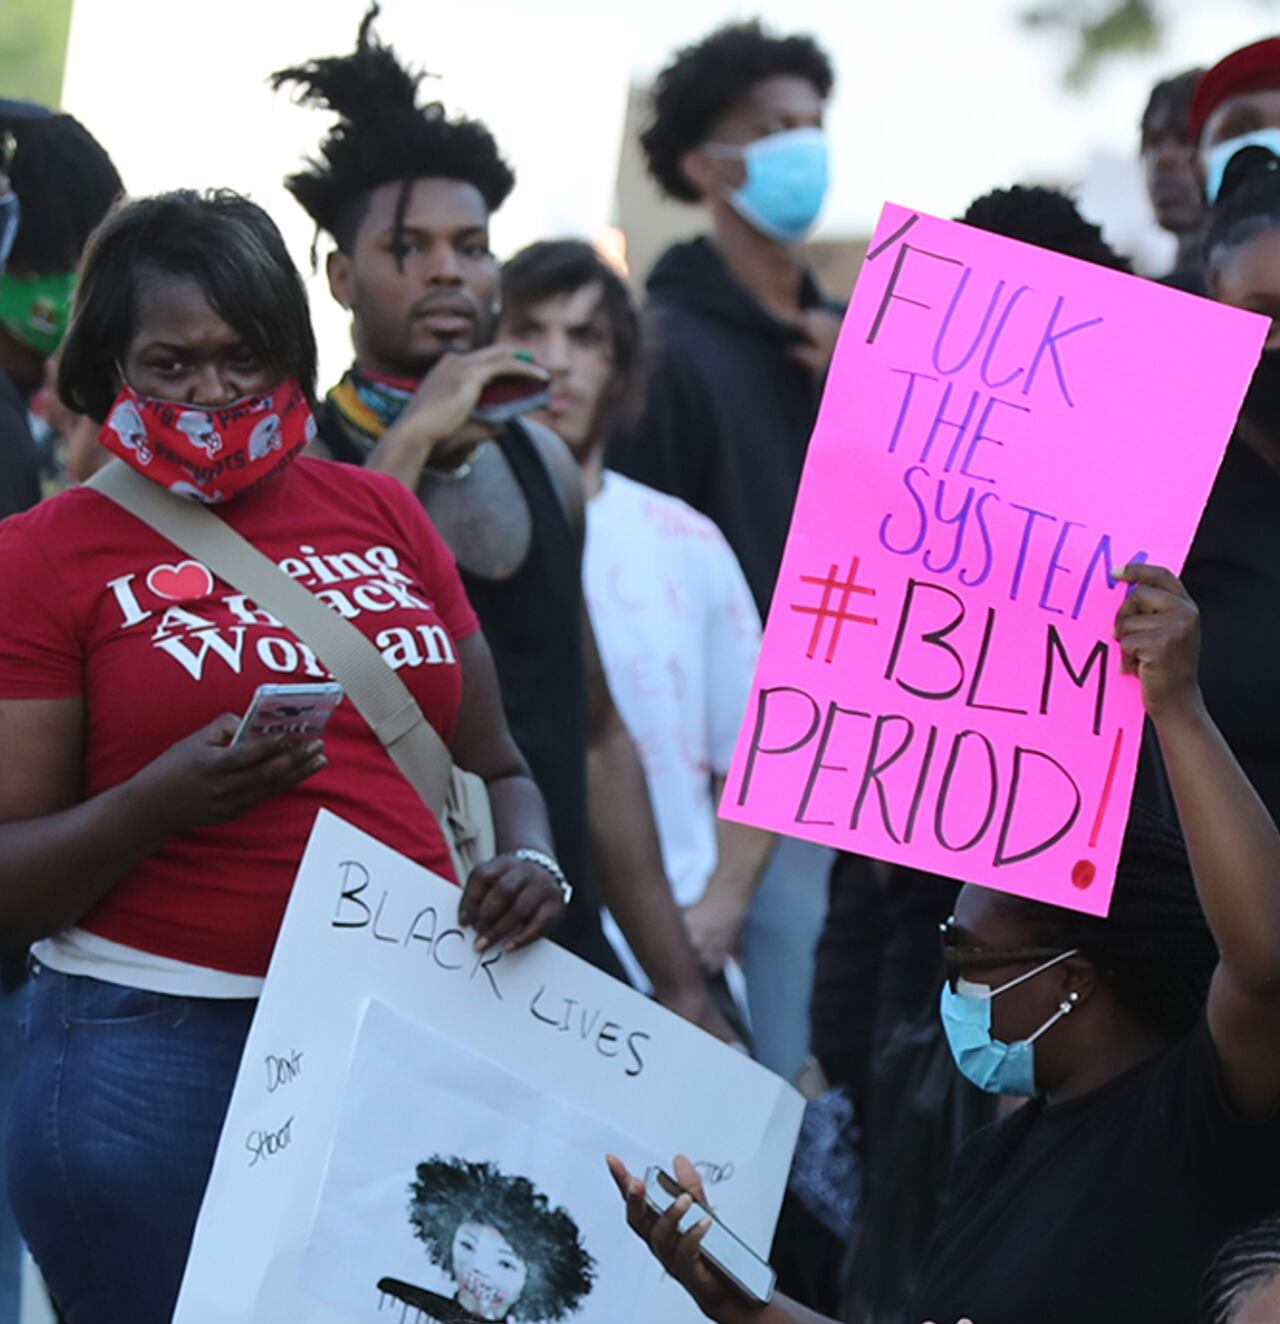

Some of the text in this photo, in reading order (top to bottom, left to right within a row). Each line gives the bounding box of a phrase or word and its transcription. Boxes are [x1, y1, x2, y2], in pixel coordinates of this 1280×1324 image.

[867, 243, 1103, 408] FUCK
[887, 367, 1032, 485] THE
[879, 466, 1150, 621] SYSTEM
[790, 555, 1109, 736] #BLM
[737, 687, 1124, 890] PERIOD!
[331, 861, 650, 1076] BLACK LIVES
